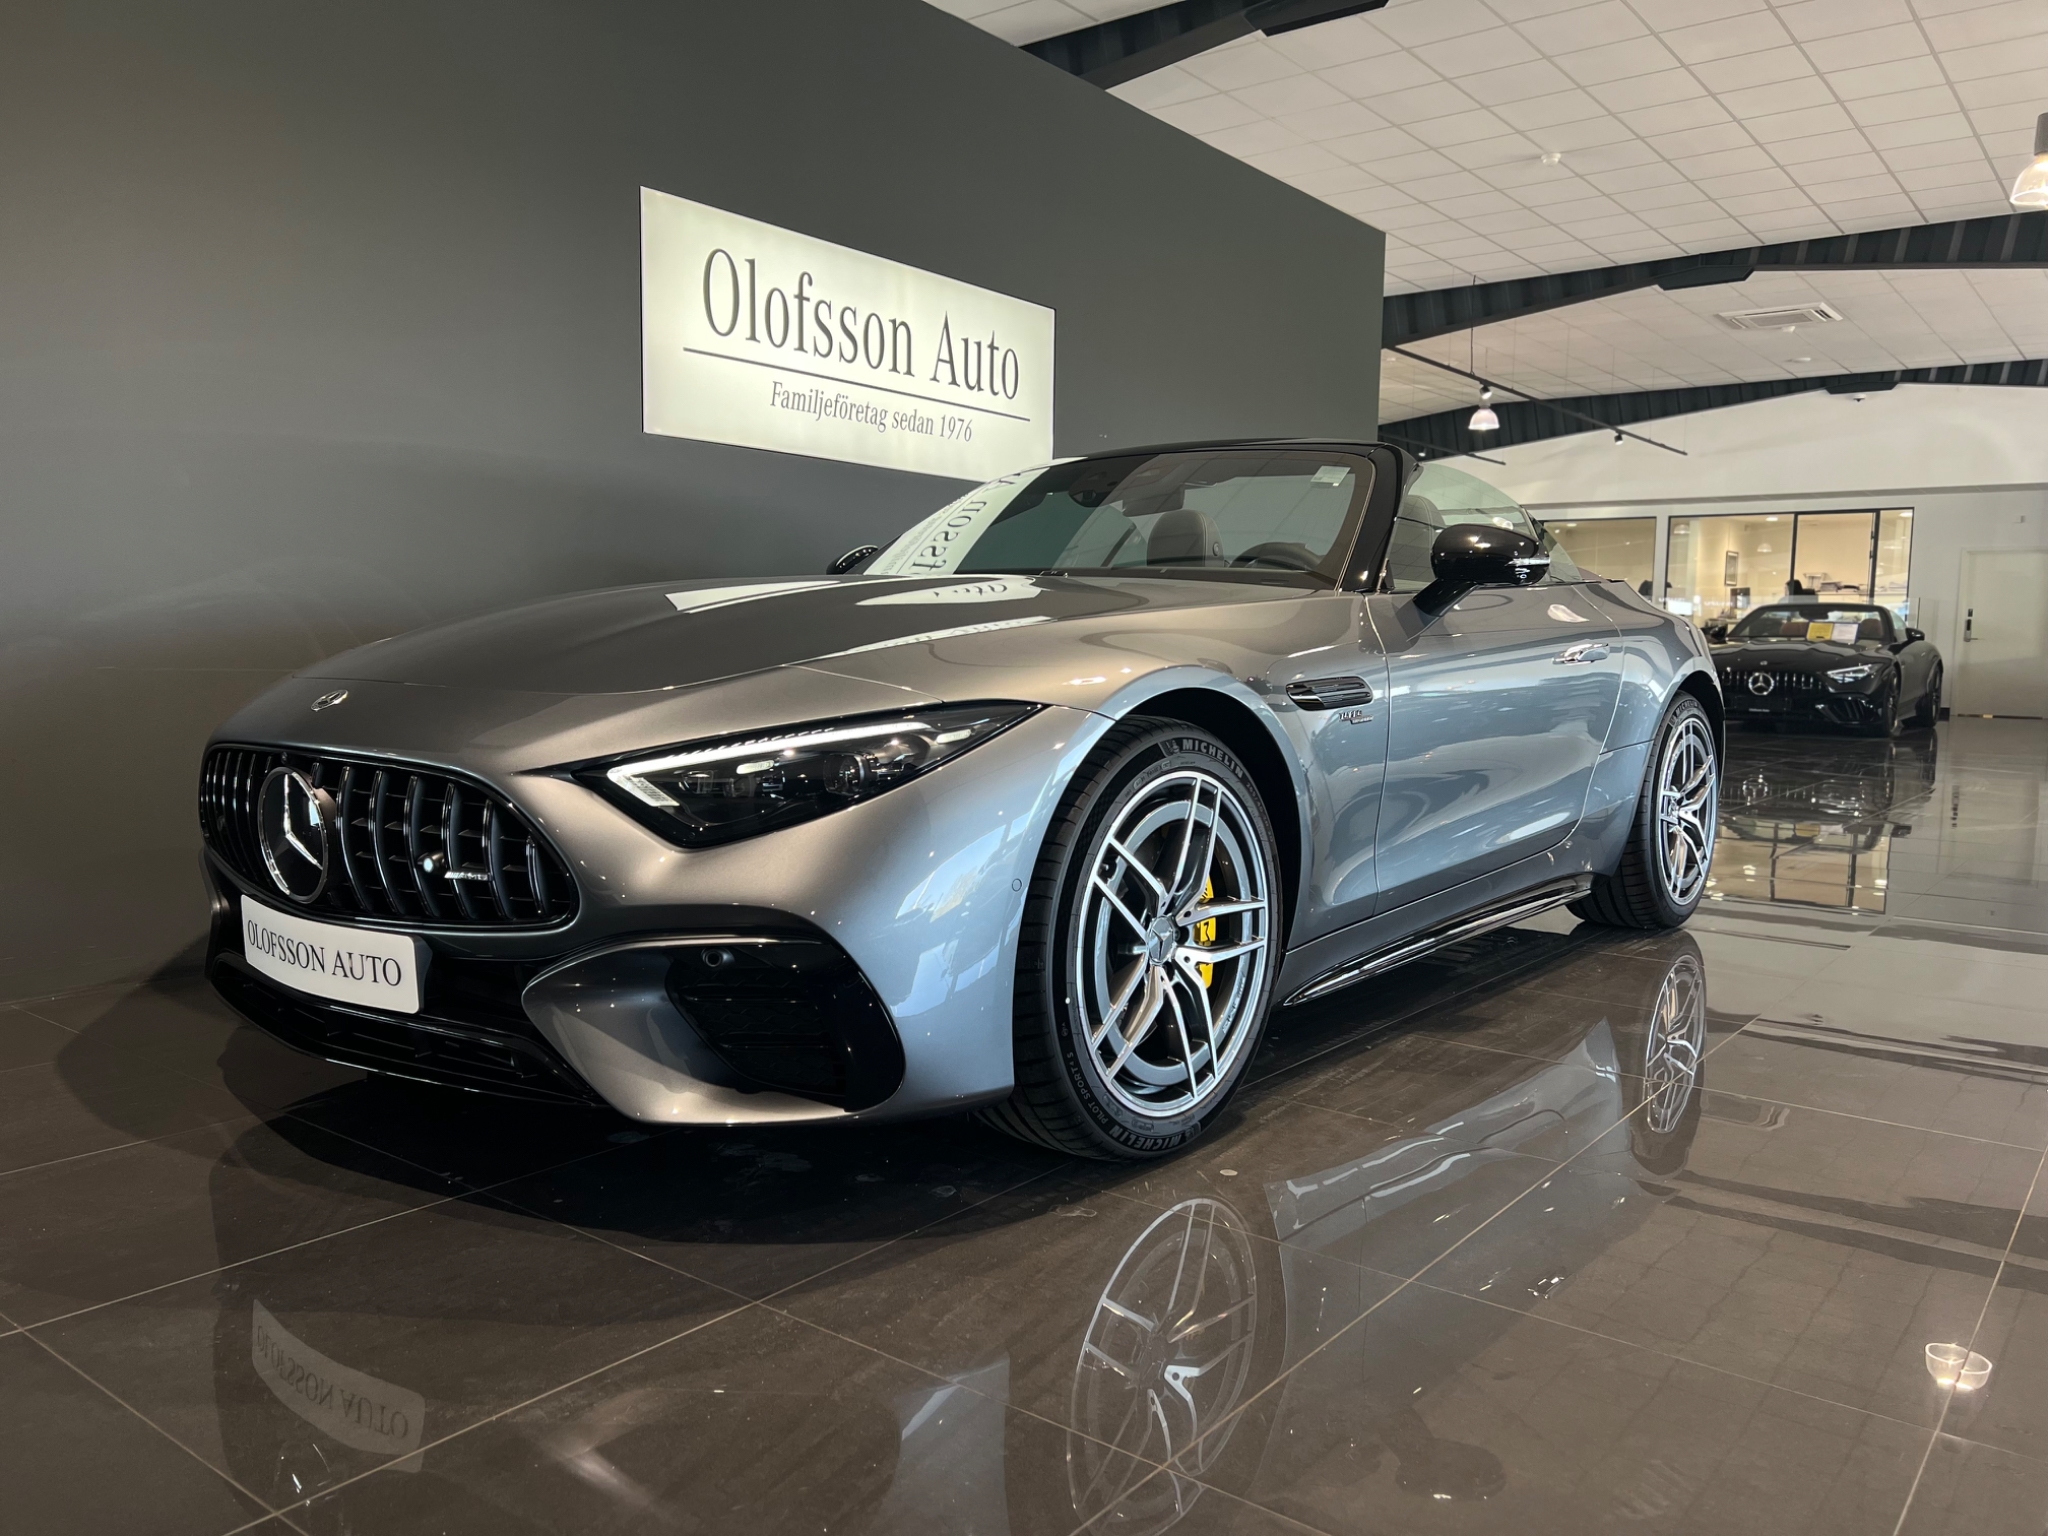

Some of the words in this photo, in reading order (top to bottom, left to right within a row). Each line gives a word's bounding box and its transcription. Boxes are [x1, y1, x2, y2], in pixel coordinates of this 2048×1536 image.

[702, 248, 915, 377] Olofsson
[929, 310, 1019, 400] Auto
[769, 380, 888, 432] Familjeföretag
[891, 408, 934, 436] sedan
[939, 414, 972, 442] 1976
[1182, 738, 1244, 778] MICHELIN
[247, 919, 325, 973] OLOFSSON
[331, 950, 402, 986] AUTO
[1070, 1067, 1091, 1100] SPORT
[1088, 1101, 1108, 1124] PILOT
[1108, 1125, 1183, 1151] MICHELIN
